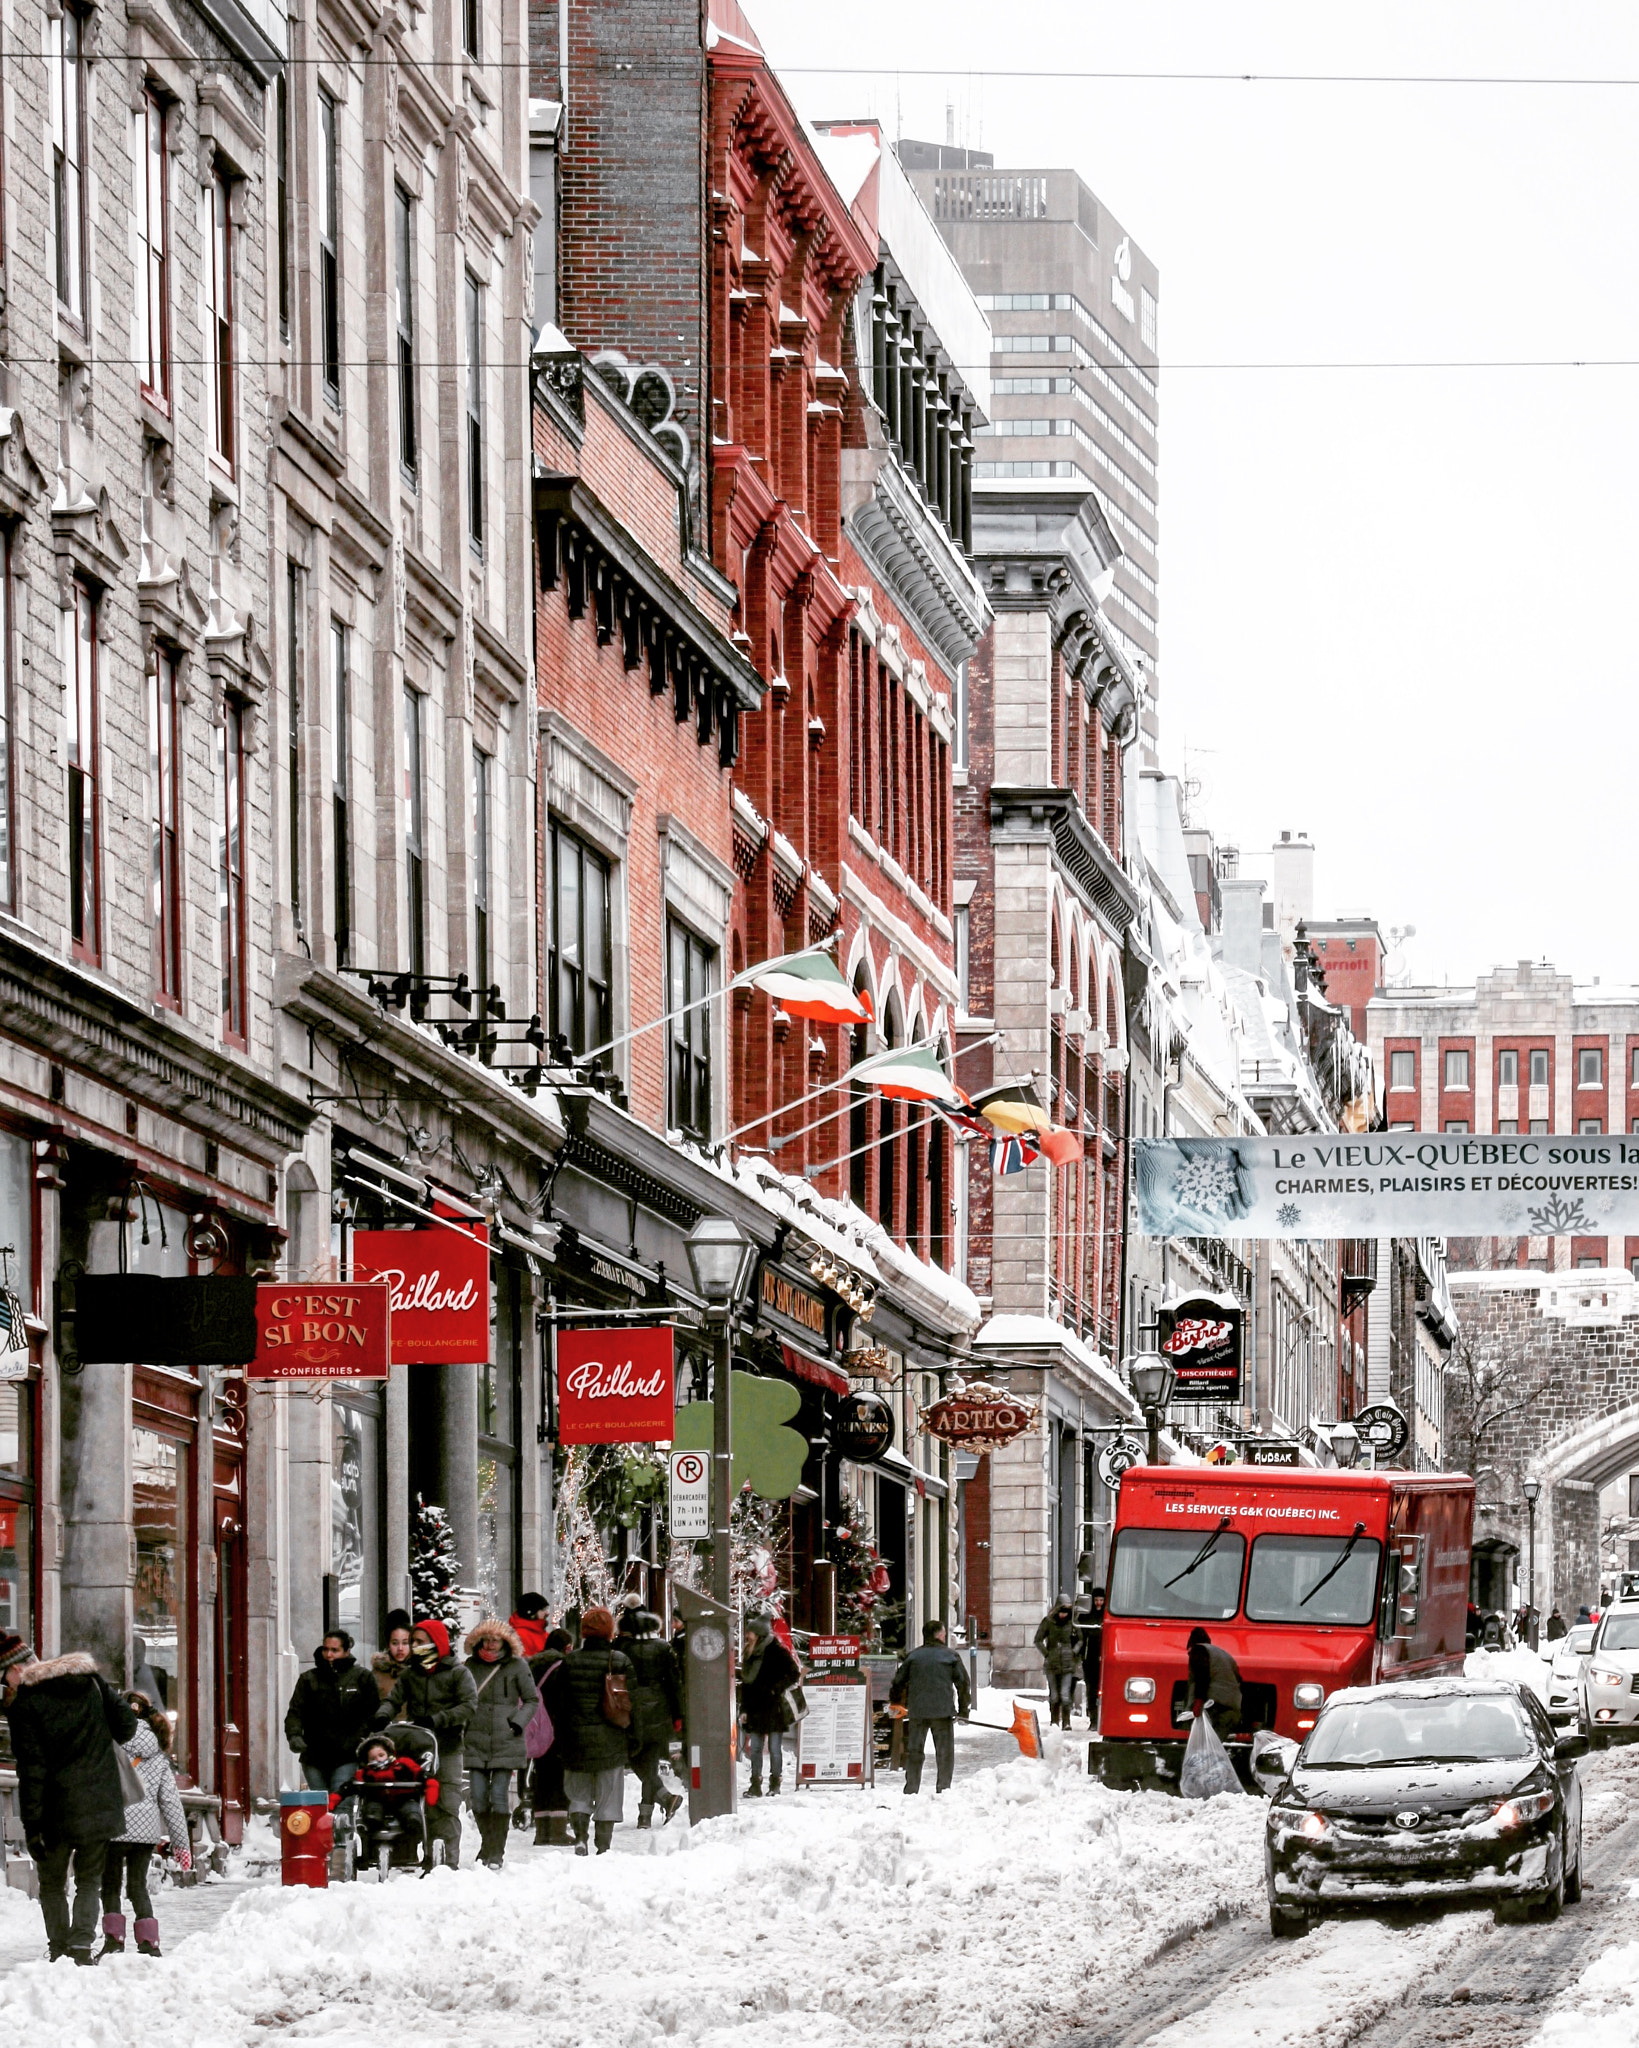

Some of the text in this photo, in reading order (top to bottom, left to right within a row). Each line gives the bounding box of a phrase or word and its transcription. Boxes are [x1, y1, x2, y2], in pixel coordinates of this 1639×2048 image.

[1317, 958, 1368, 970] arriott
[1272, 1149, 1305, 1168] Le
[1313, 1141, 1539, 1171] VIEUX-QUÉBEC
[1549, 1148, 1611, 1164] sous
[1275, 1173, 1638, 1195] CHARMES, PLAISIRS ET DÉCOUVERTES!
[271, 1295, 361, 1319] C'EST
[265, 1321, 368, 1348] SI BON
[1163, 1319, 1226, 1352] Bistro
[281, 1366, 353, 1376] CONFISERIES
[566, 1360, 666, 1400] Paillard
[936, 1409, 1019, 1431] ARTEQ
[1254, 1452, 1292, 1463] RUDSAK
[1165, 1503, 1340, 1520] LES SERVICES G&K (QUÉBEC) INC.
[695, 1519, 706, 1527] VEN
